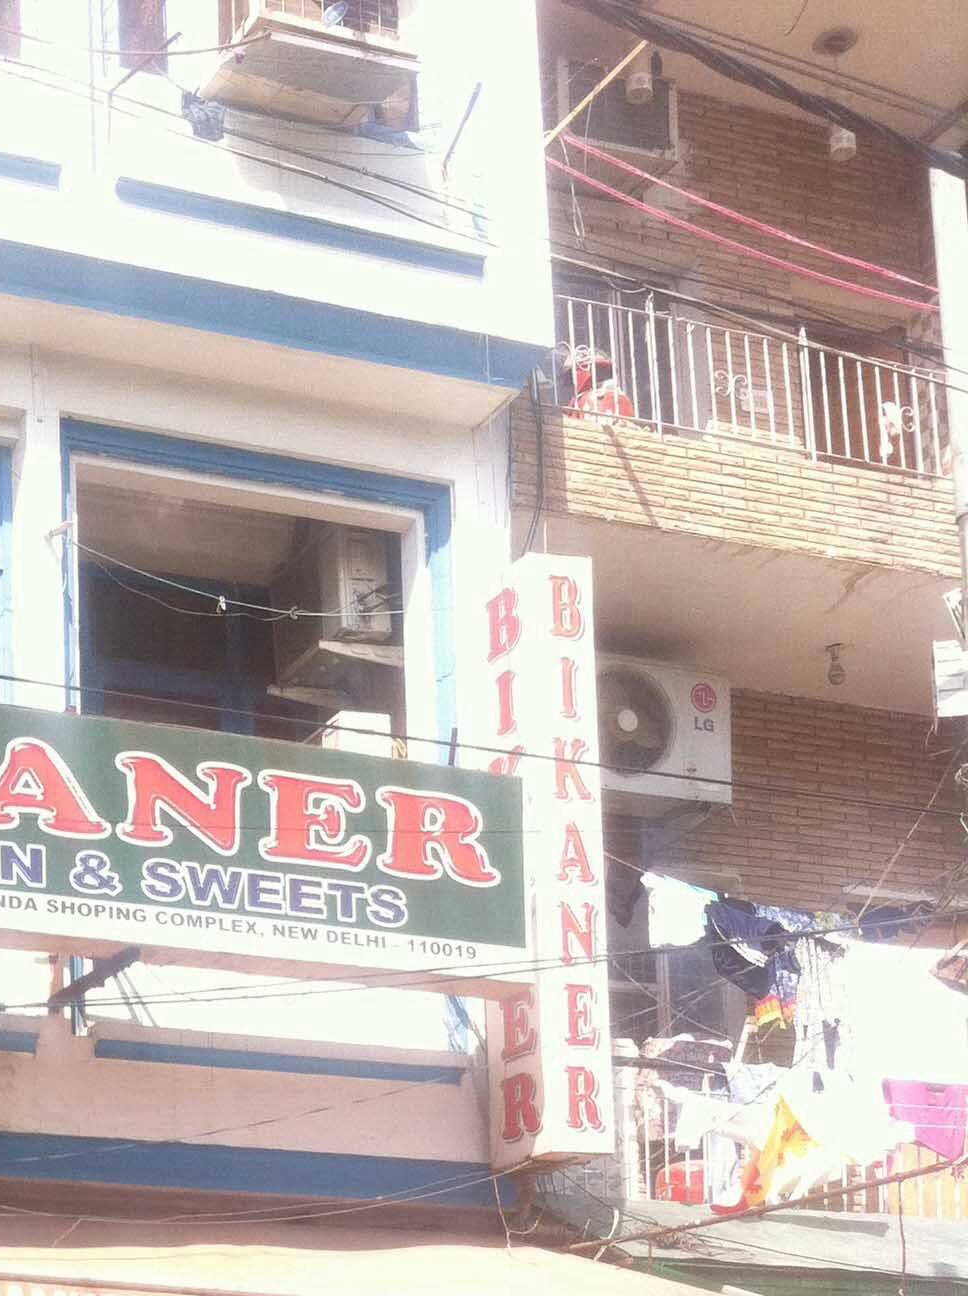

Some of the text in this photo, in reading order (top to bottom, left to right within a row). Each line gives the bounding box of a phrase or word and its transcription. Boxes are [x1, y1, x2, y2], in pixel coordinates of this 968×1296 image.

[694, 716, 714, 732] LG
[549, 574, 606, 1132] BIKANER
[70, 850, 123, 897] &
[141, 855, 407, 928] SWEETS
[46, 898, 147, 923] SHOPING
[155, 910, 264, 939] COMPLEX,
[273, 924, 318, 942] NEW
[326, 928, 386, 950] DELHI
[408, 938, 478, 960] 110019
